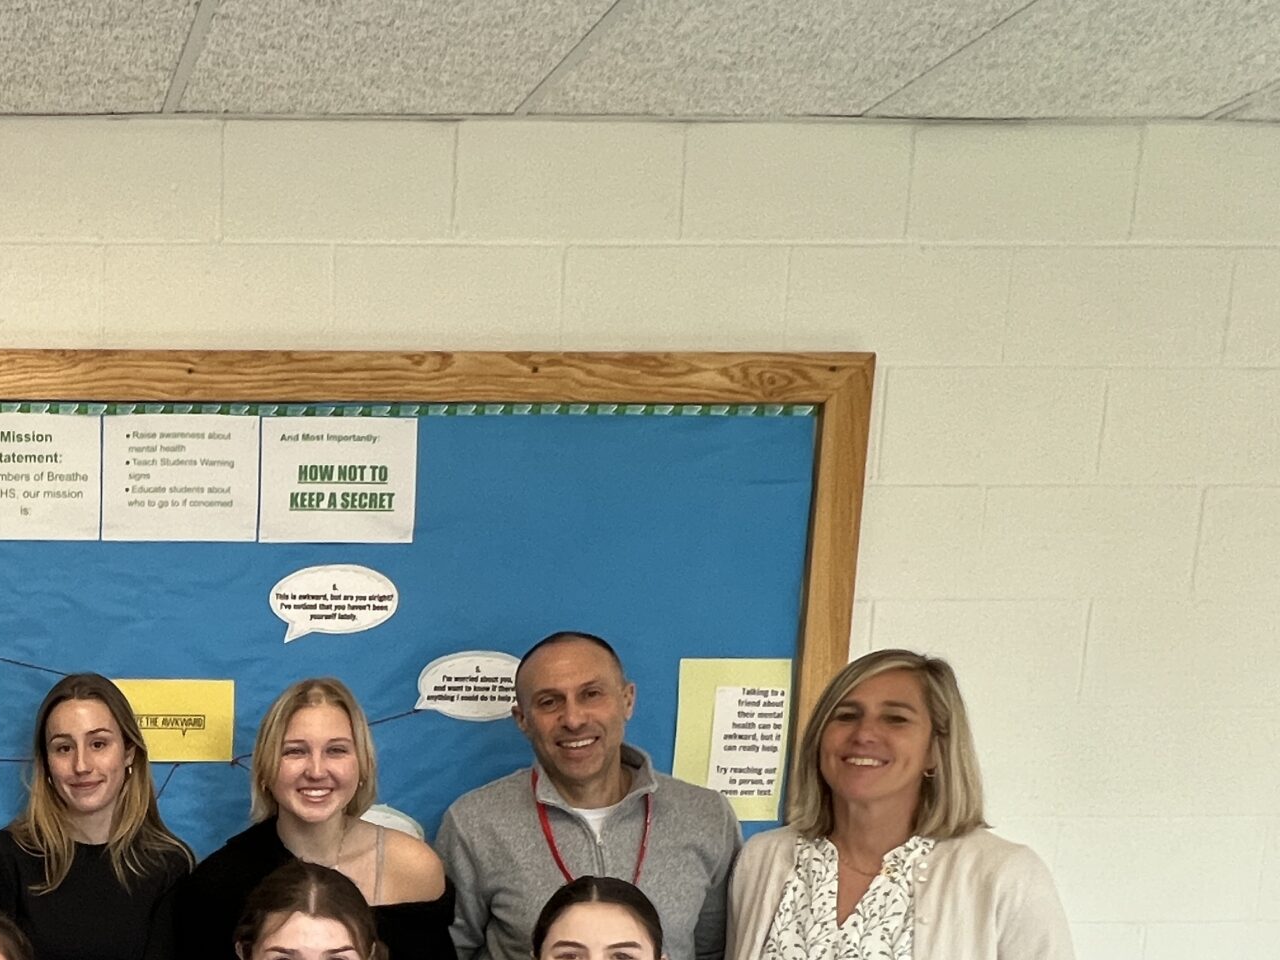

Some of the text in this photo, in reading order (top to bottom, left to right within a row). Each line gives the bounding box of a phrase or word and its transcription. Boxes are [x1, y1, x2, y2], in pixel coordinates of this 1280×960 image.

[0, 431, 52, 443] Mission
[132, 431, 231, 440] Raise awareness about
[280, 433, 380, 444] And Most Importantly:
[128, 445, 186, 453] mental health
[132, 458, 234, 469] Teach Students Warning
[33, 471, 45, 482] of
[47, 472, 88, 482] Breathe
[128, 472, 150, 481] signs
[298, 465, 388, 482] HOW NOT TO
[23, 490, 40, 499] our
[43, 488, 83, 499] mission
[132, 485, 231, 494] Educate students about
[128, 499, 233, 510] who to go to if concerned
[289, 492, 395, 509] KEEP A SECRET
[20, 506, 31, 515] is:
[310, 613, 337, 621] yourself
[742, 688, 768, 698] Talking
[738, 699, 760, 707] friend
[738, 710, 755, 718] their
[162, 718, 203, 727] AWKWARD
[723, 733, 781, 741] awkward, but it
[738, 744, 760, 752] really
[716, 765, 727, 774] Try
[730, 766, 762, 775] reaching
[729, 776, 736, 784] in
